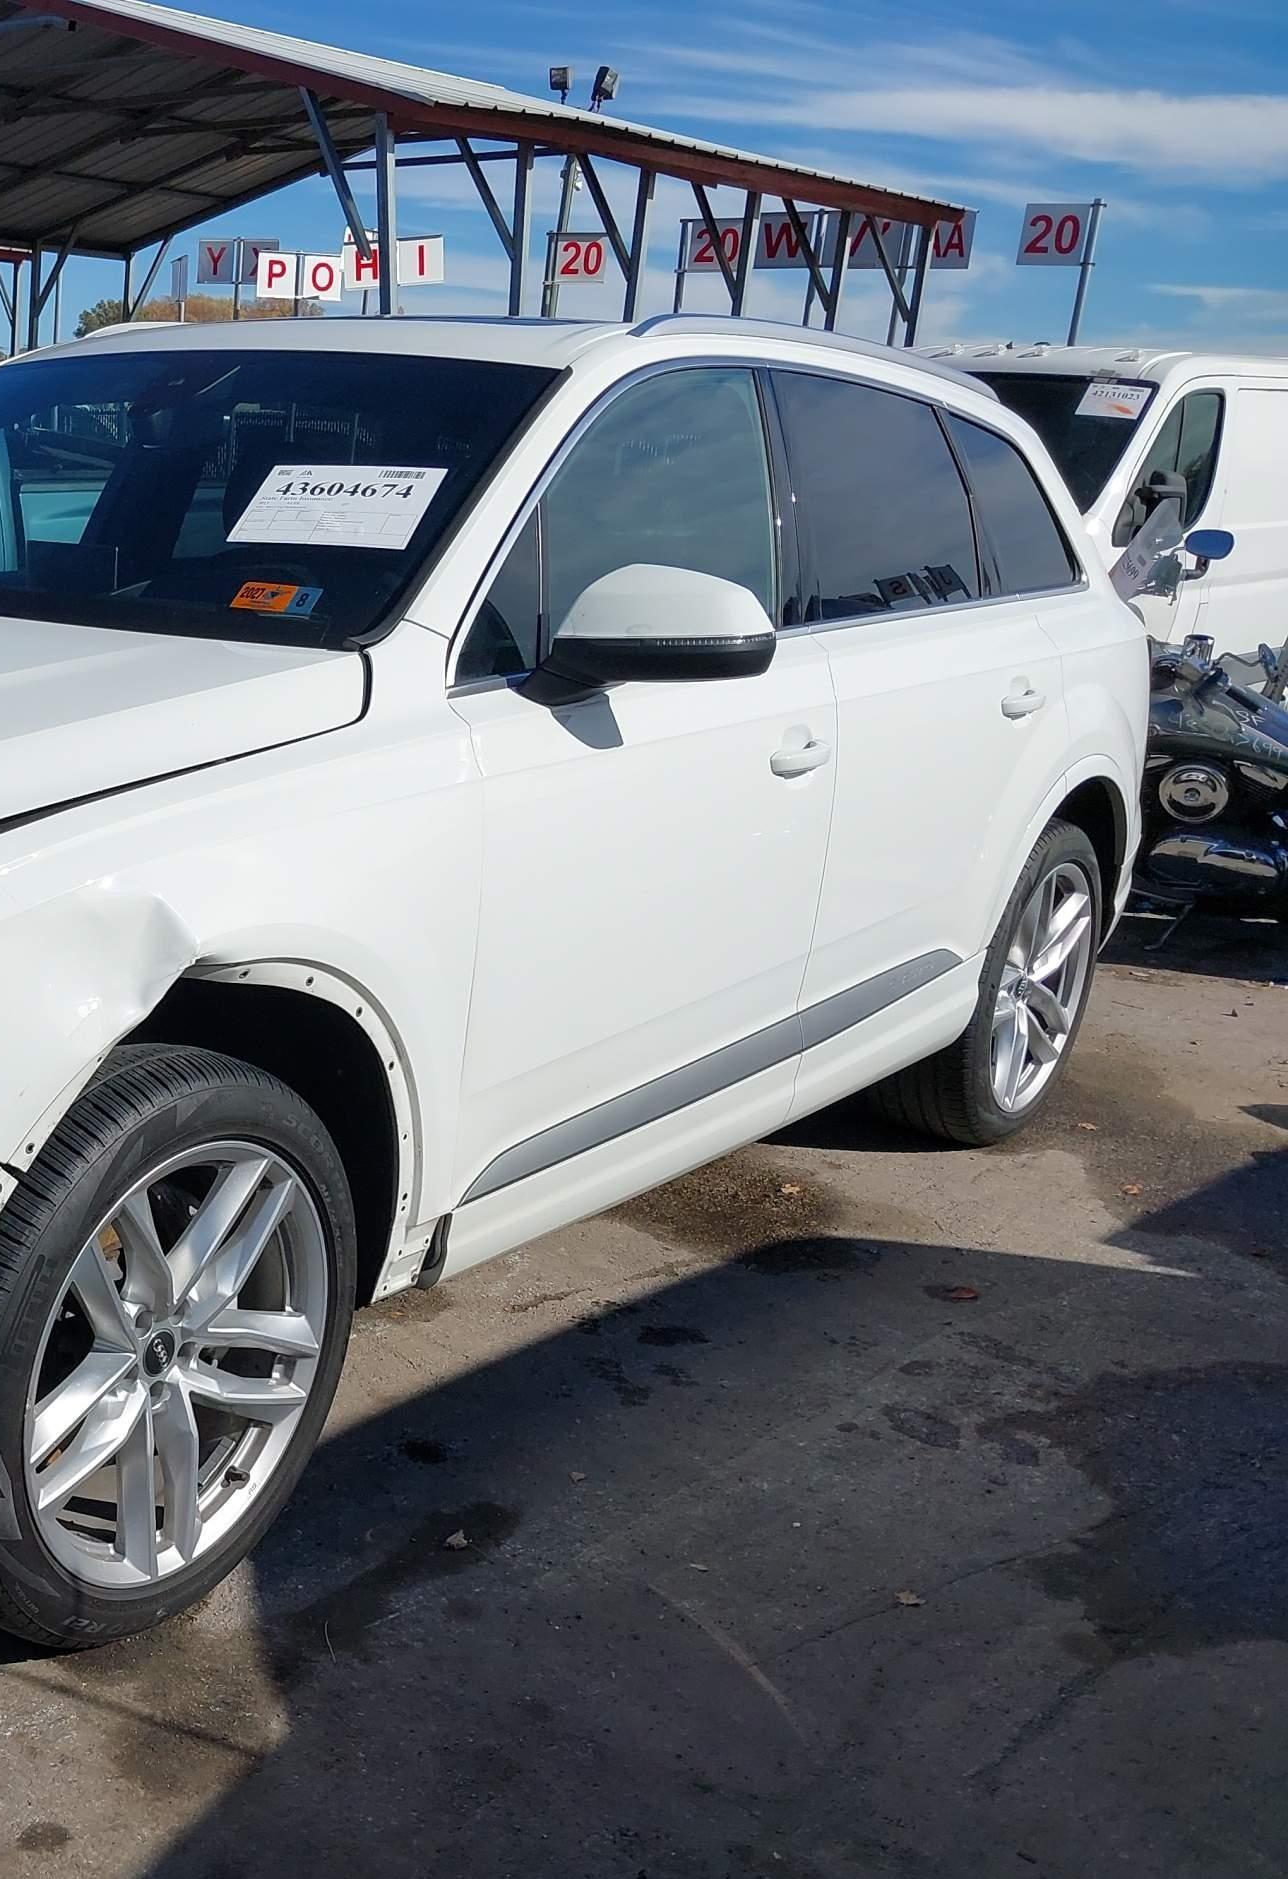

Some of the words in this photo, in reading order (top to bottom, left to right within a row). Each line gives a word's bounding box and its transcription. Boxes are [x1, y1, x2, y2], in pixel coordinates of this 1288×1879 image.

[694, 228, 739, 262] 20
[764, 222, 808, 258] W
[1024, 215, 1080, 254] 20
[206, 247, 226, 275] Y
[355, 249, 378, 281] H
[418, 245, 425, 276] I
[561, 241, 602, 275] 20
[267, 260, 287, 289] P
[276, 481, 414, 499] 43604674
[240, 587, 266, 600] 2027
[296, 593, 310, 608] 8
